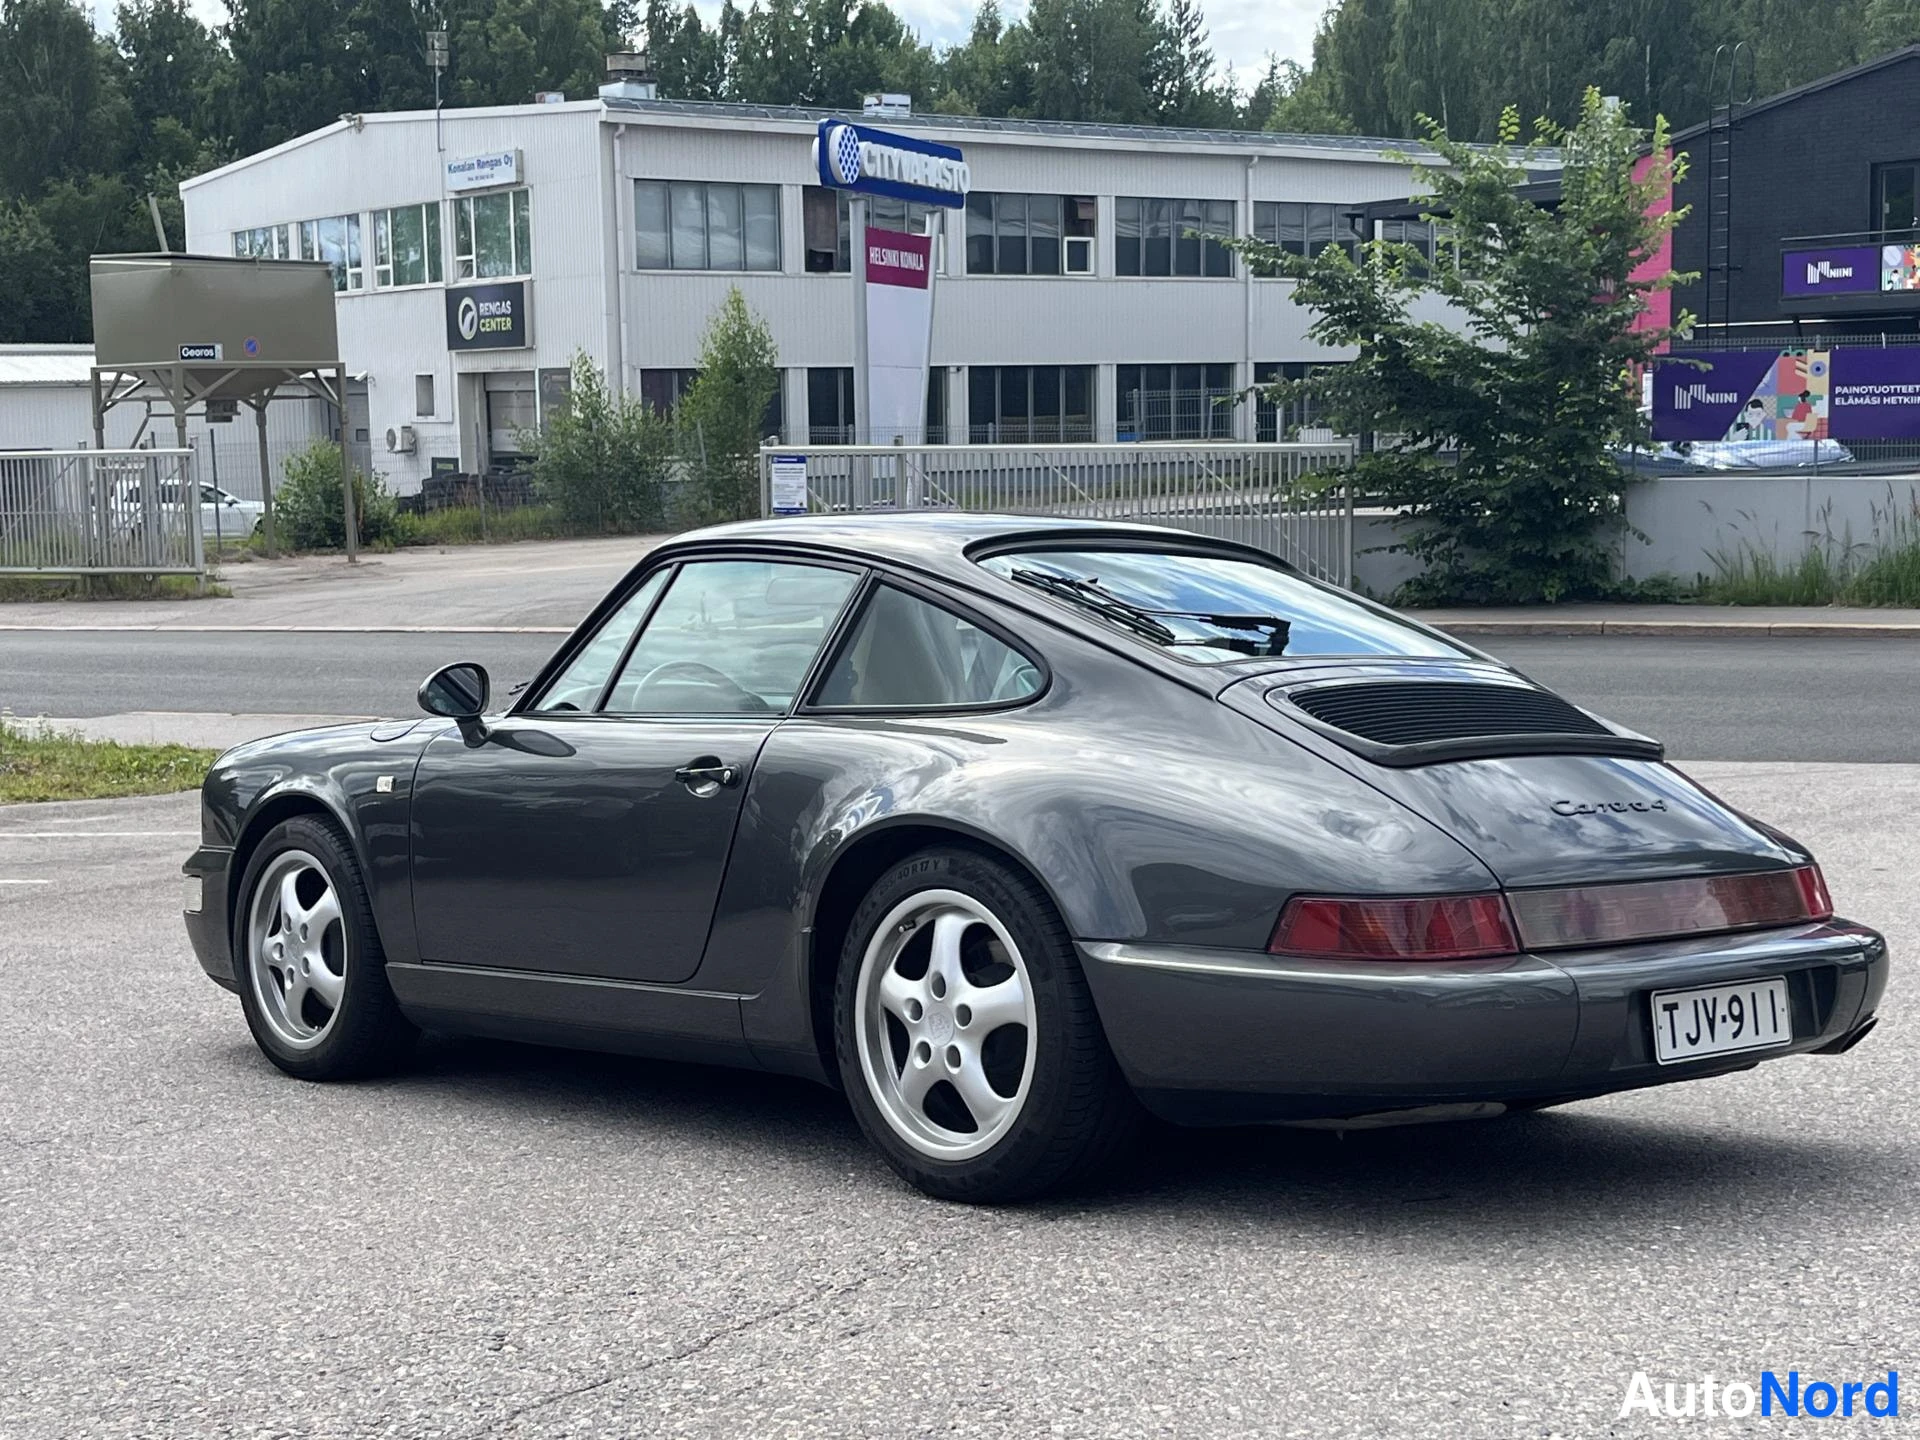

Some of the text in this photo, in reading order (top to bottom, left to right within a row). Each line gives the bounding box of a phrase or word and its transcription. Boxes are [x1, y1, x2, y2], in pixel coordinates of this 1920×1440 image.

[448, 154, 513, 174] Konalan Rengas Oy
[862, 141, 970, 194] CITYVARASTO
[869, 246, 924, 271] HELSINKI KONALA
[479, 300, 512, 316] RENGAS
[479, 317, 512, 332] CENTER
[181, 347, 214, 357] Georos
[1835, 385, 1920, 394] PAINOTUOTTEET
[1835, 395, 1881, 406] ELÄMÄSI
[1662, 989, 1778, 1050] TJV-911
